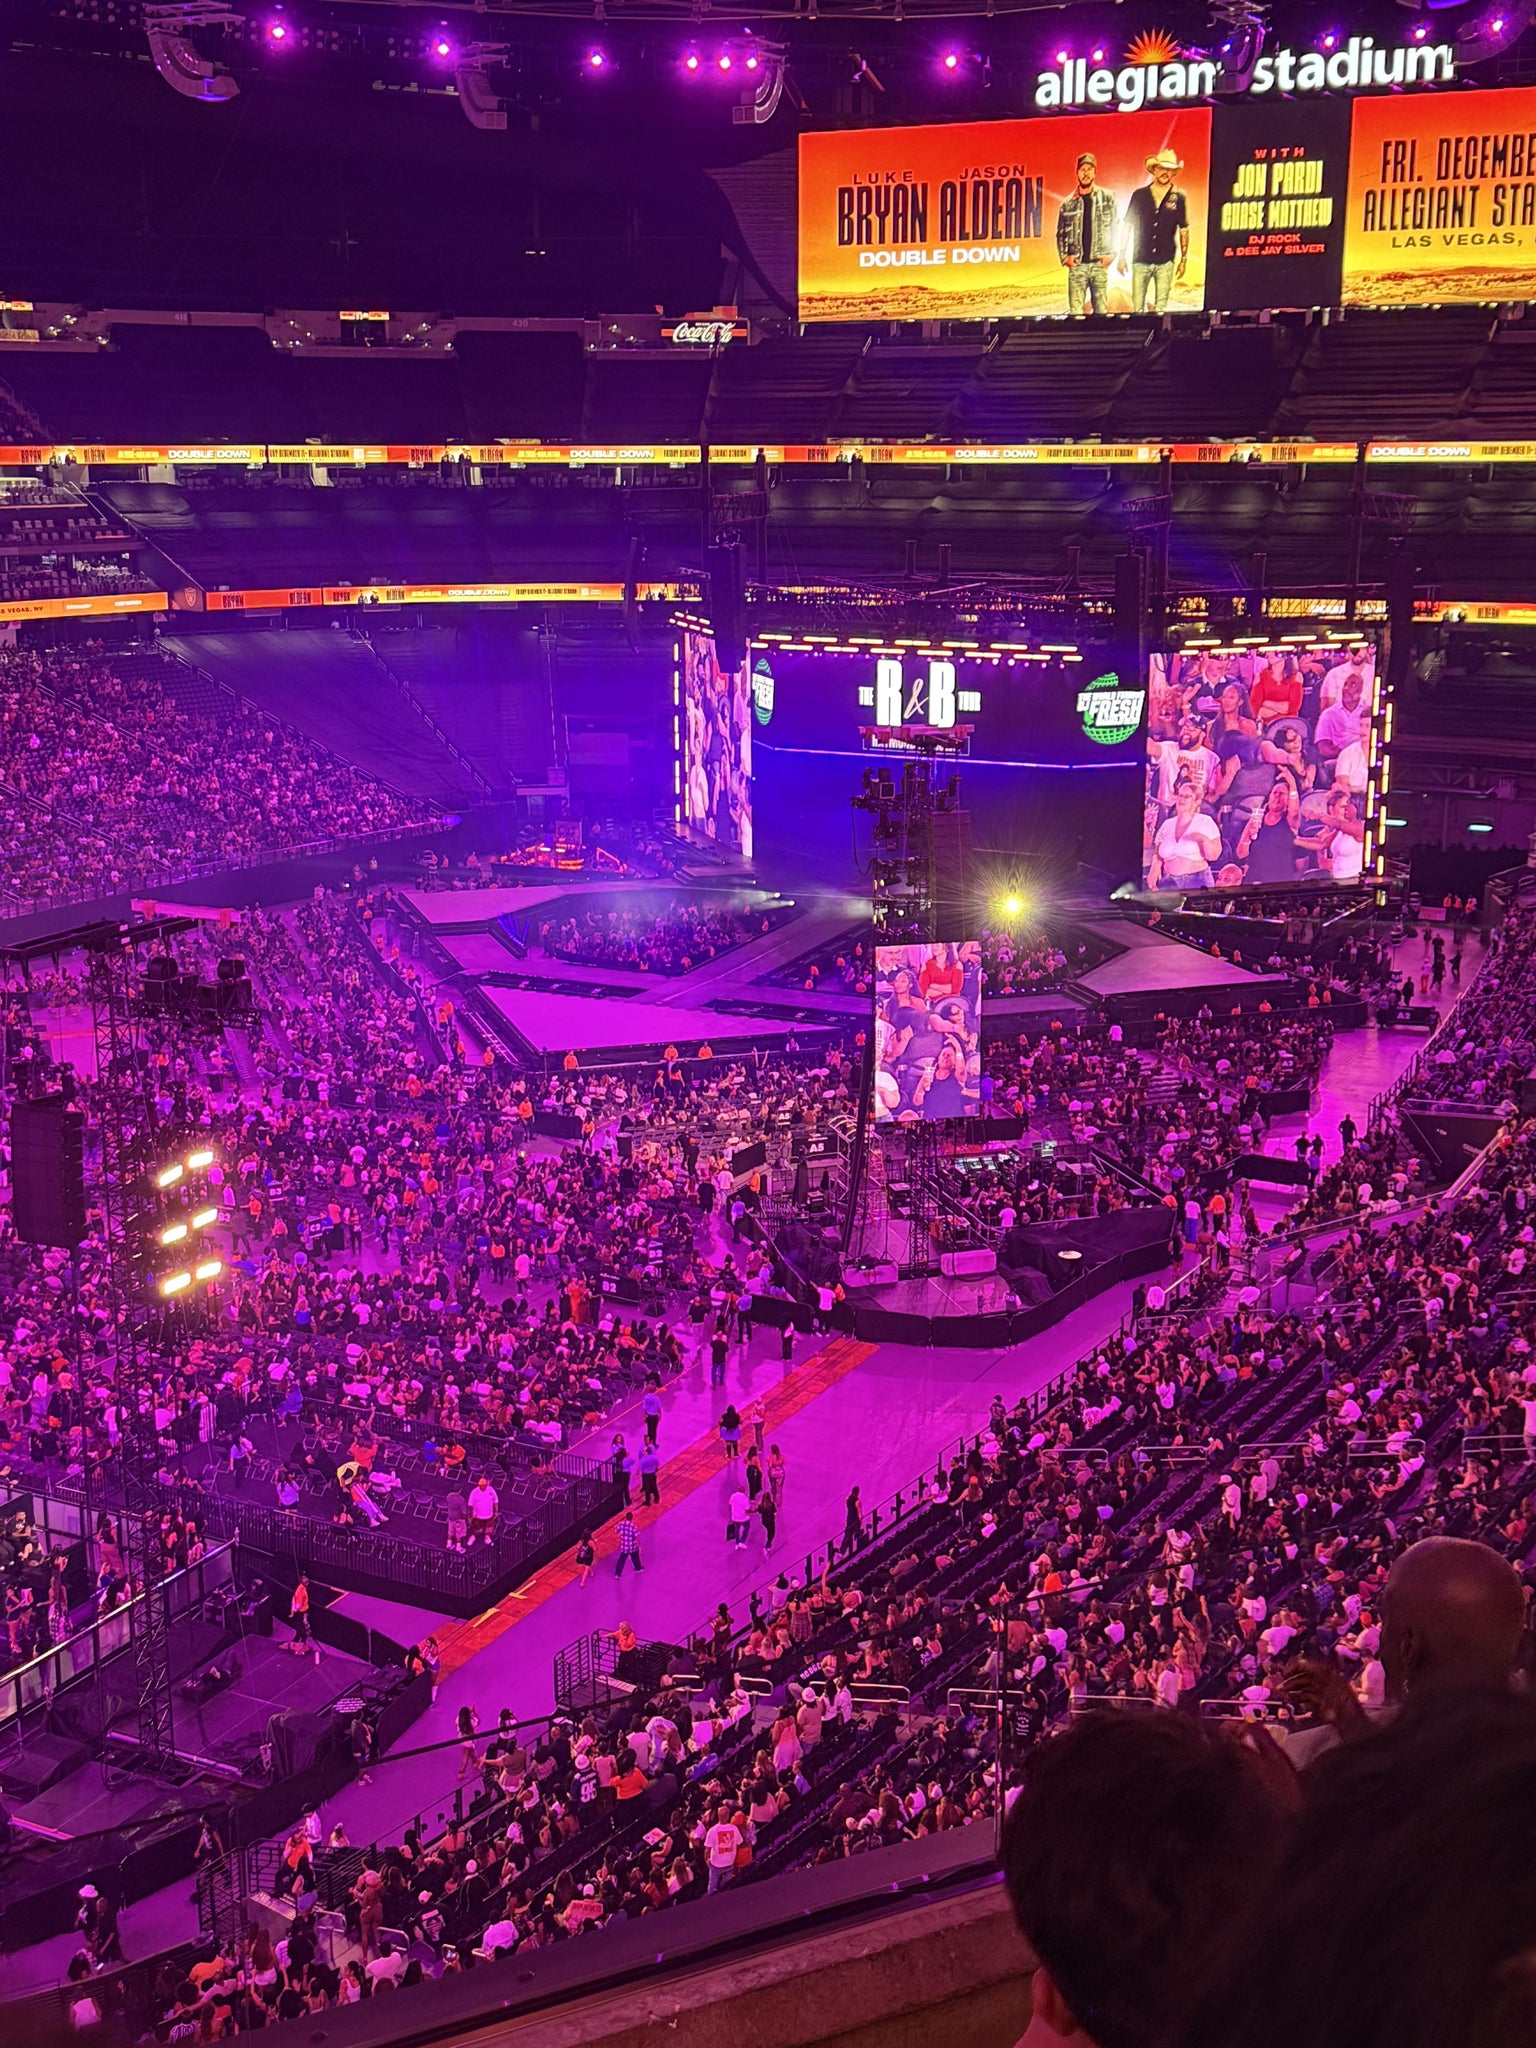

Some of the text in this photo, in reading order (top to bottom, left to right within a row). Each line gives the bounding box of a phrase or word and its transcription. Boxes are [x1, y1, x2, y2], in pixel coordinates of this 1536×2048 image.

[1035, 37, 1450, 112] allegian stadium
[1254, 147, 1305, 159] WITH
[1381, 132, 1536, 183] FRI. DECEMBE
[854, 165, 1025, 184] LUKE JASON
[1232, 160, 1324, 198] JON PARDI
[838, 176, 1044, 246] BRYAN ALDEAN
[1221, 197, 1333, 232] CHASE MATTHEW
[1363, 185, 1480, 232] ALLEGIANT
[1248, 233, 1301, 245] DJ ROCK
[1392, 232, 1523, 248] LAS VEGAS,
[859, 246, 1020, 268] DOUBLE DOWN
[1224, 243, 1325, 257] & DEE JAY SILVER
[512, 319, 529, 327] 420
[21, 449, 42, 464] BRYAN
[168, 449, 215, 459] DOUBLE
[216, 449, 251, 459] DOWN
[410, 449, 433, 462] BRYAN
[479, 448, 504, 462] ALDEAN
[569, 449, 617, 459] DOUBLE
[618, 449, 656, 459] DOWN
[807, 448, 829, 461] BRYAN
[871, 448, 893, 462] ALDEAN
[955, 449, 1001, 459] DOUBLE
[1002, 449, 1038, 459] DOWN
[1198, 447, 1221, 461] BRYAN
[1271, 447, 1297, 461] ALDEAN
[1371, 446, 1427, 457] DOUBLE
[1428, 446, 1471, 457] DOWN
[1088, 698, 1143, 720] FRESH
[1396, 1012, 1411, 1020] A2
[778, 1112, 790, 1121] A5
[809, 1142, 825, 1153] A5
[800, 1662, 822, 1680] DODGE
[581, 1779, 597, 1803] 95
